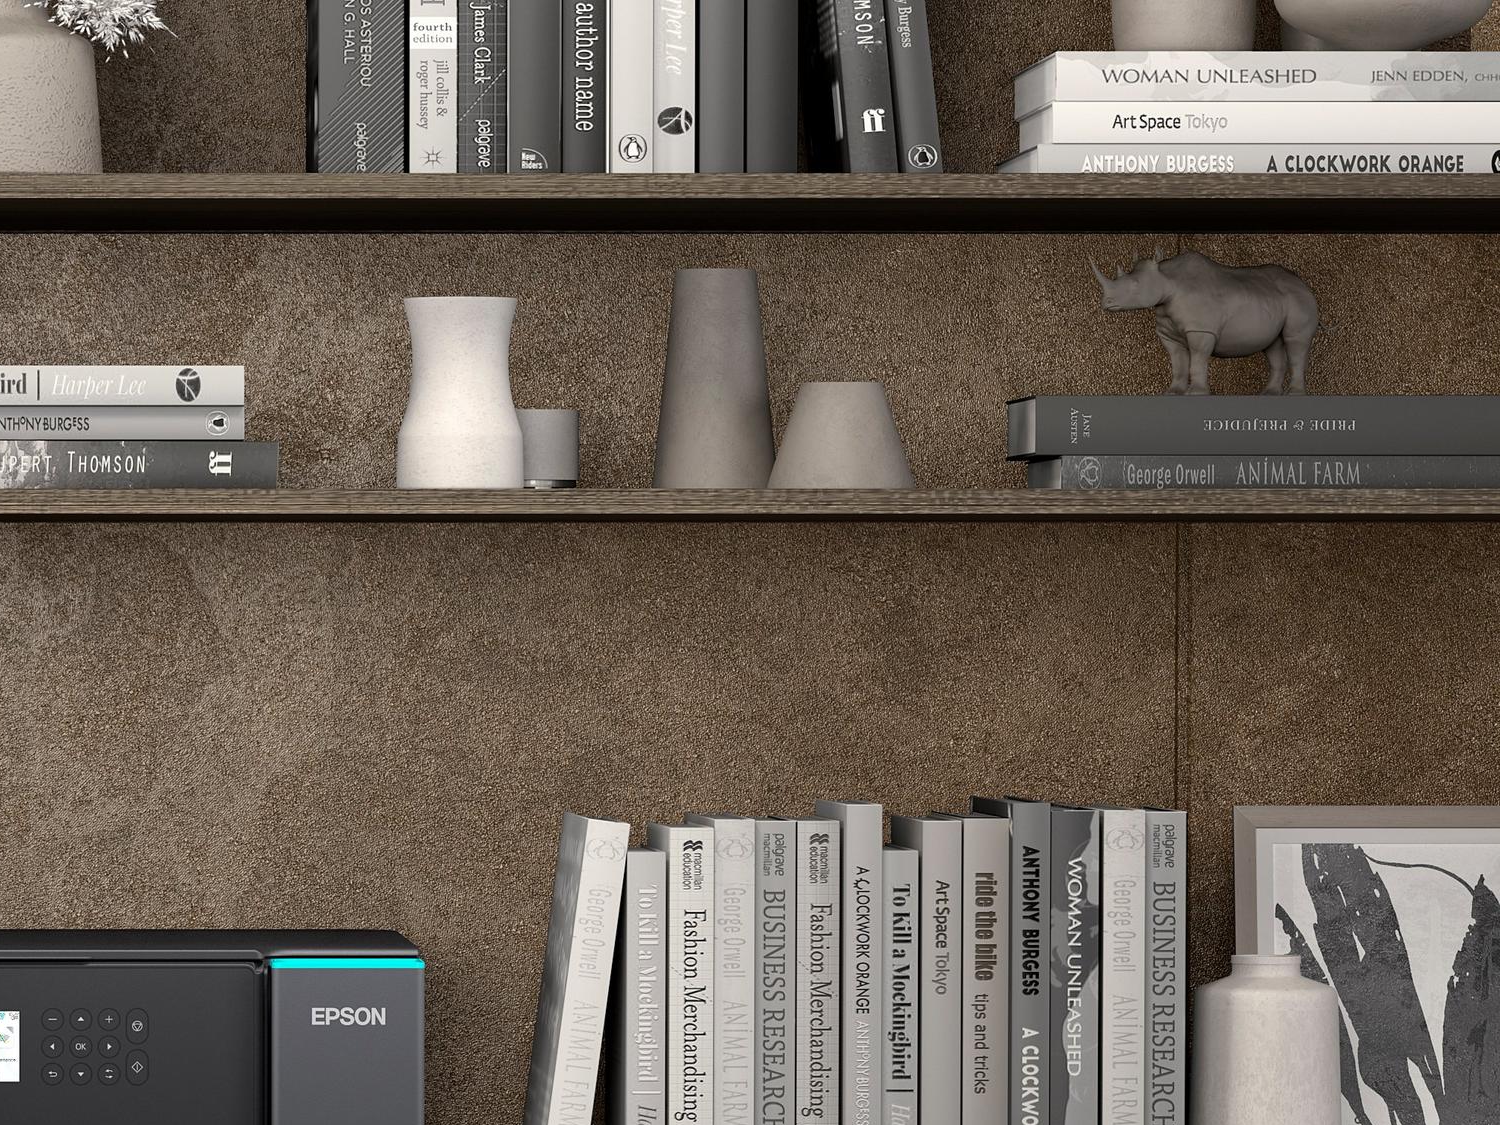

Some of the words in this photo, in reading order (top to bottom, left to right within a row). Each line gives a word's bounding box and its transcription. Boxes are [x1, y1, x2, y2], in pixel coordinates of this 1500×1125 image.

[344, 12, 355, 25] G.
[413, 22, 453, 32] fourth
[470, 2, 491, 43] James
[575, 3, 599, 71] author
[897, 6, 912, 48] Burgess
[344, 29, 355, 64] HALL
[360, 19, 372, 87] ASTERIOU
[413, 34, 453, 44] edition
[416, 60, 428, 90] roger
[433, 60, 449, 74] jill
[474, 47, 491, 85] Clark
[665, 44, 687, 75] Lee
[1102, 69, 1189, 83] WOMAN
[1197, 69, 1317, 83] UNLEASHED
[1370, 70, 1408, 83] JENN
[1413, 70, 1468, 83] EDDEN,
[437, 77, 449, 104] collis
[575, 77, 594, 131] name
[417, 92, 432, 129] hussey
[437, 108, 448, 117] &
[861, 108, 886, 133] ff
[1112, 114, 1137, 129] Art
[1139, 114, 1181, 132] Space
[1185, 114, 1228, 133] Tokyo
[354, 121, 368, 172] palgrave
[474, 119, 493, 168] palgrave
[521, 152, 536, 160] New
[521, 160, 543, 170] Riders
[1081, 155, 1160, 173] ANTHONY
[1167, 155, 1235, 173] BURGESS
[1266, 155, 1278, 172] A
[1284, 155, 1392, 173] CLOCKWORK
[1398, 155, 1464, 173] ORANGE
[51, 375, 114, 399] Harper
[116, 375, 147, 396] Lee
[1070, 408, 1079, 445] AUSTEN
[1081, 414, 1092, 438] JANE
[1204, 418, 1287, 431] PREJUDICE
[1293, 419, 1304, 431] &
[1310, 420, 1356, 431] PRIDE
[1127, 464, 1171, 489] George
[1175, 464, 1215, 485] Orwell
[1236, 457, 1307, 486] ANIMAL
[1313, 461, 1361, 486] FARM
[772, 833, 784, 876] palgrave
[1163, 824, 1175, 868] palgrave
[683, 853, 692, 890] education
[693, 853, 702, 890] macmillan
[809, 846, 818, 884] education
[820, 846, 829, 884] macmillan
[856, 866, 870, 875] A
[638, 885, 658, 907] To
[892, 884, 910, 906] To
[936, 880, 950, 905] Art
[974, 872, 997, 907] ride
[1022, 845, 1040, 923] ANTHONY
[1067, 857, 1083, 946] WOMAN
[1107, 879, 1136, 926] George
[580, 889, 612, 934] George
[718, 887, 746, 934] George
[853, 878, 870, 959] CLOCKWORK
[892, 912, 912, 944] Kill
[933, 906, 950, 949] Space
[974, 911, 997, 940] the
[638, 913, 660, 946] Kill
[684, 909, 706, 979] Fashion
[763, 889, 785, 1001] BUSINESS
[810, 903, 832, 974] Fashion
[1153, 882, 1176, 996] BUSINESS
[578, 939, 605, 980] Orwell
[638, 950, 652, 960] a
[723, 938, 746, 978] Orwell
[892, 948, 906, 958] a
[974, 944, 997, 981] bike
[1021, 929, 1040, 996] BURGESS
[1112, 930, 1136, 972] Orwell
[856, 962, 870, 1014] ORANGE
[932, 952, 950, 995] Tokyo
[311, 1007, 386, 1026] EPSON
[636, 966, 659, 1082] Mockingbird
[888, 964, 912, 1080] Mockingbird
[971, 993, 988, 1019] tips
[1066, 954, 1082, 1076] UNLEASHED
[566, 999, 600, 1072] ANIMAL
[723, 1001, 748, 1072] ANIMAL
[801, 980, 832, 1118] Merchandising
[974, 1024, 989, 1050] and
[1021, 1027, 1040, 1039] A
[1112, 995, 1138, 1070] ANIMAL
[674, 986, 706, 1122] Merchandising
[974, 1056, 989, 1094] tricks
[1112, 1078, 1138, 1125] FARM
